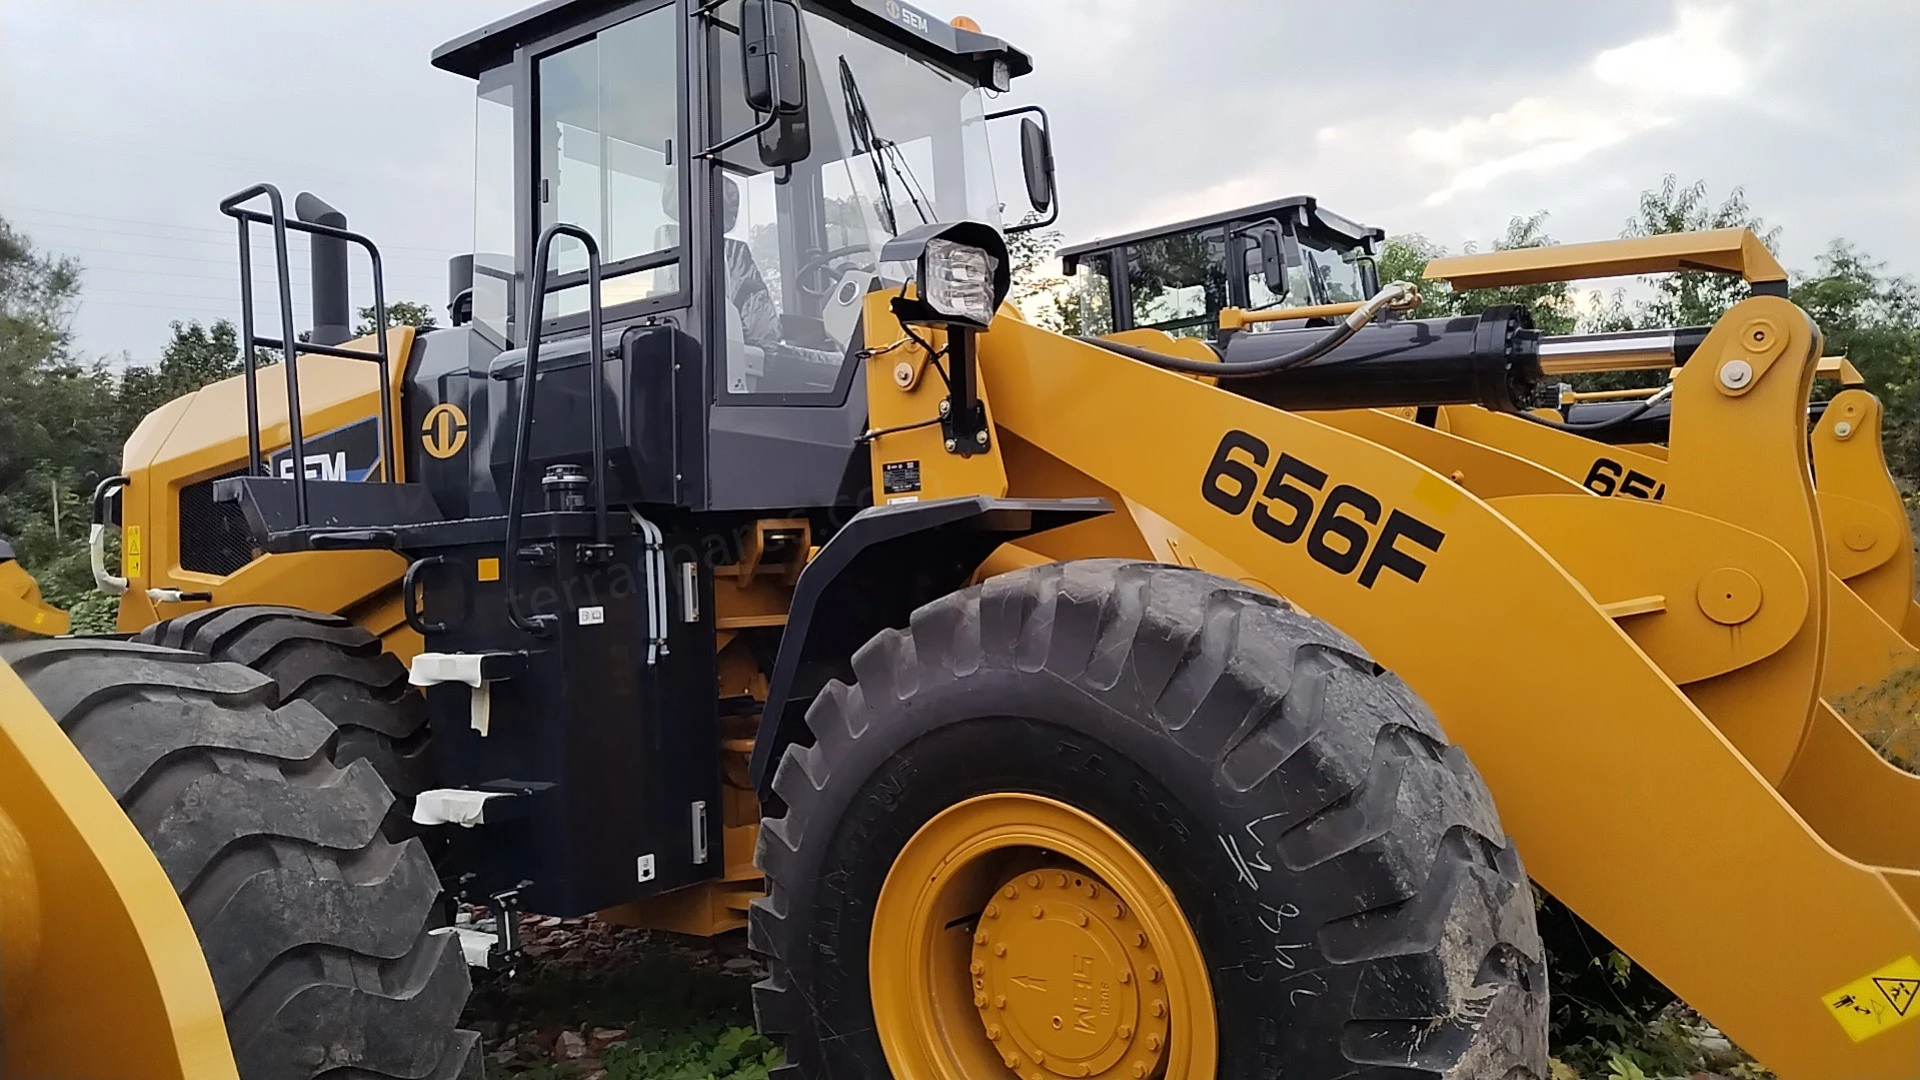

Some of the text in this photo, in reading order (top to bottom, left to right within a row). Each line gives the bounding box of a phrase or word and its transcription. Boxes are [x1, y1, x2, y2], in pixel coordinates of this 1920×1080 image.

[902, 8, 928, 33] SEM
[1201, 429, 1446, 589] 656F
[1583, 457, 1665, 500] 65
[1073, 953, 1096, 1034] SEM
